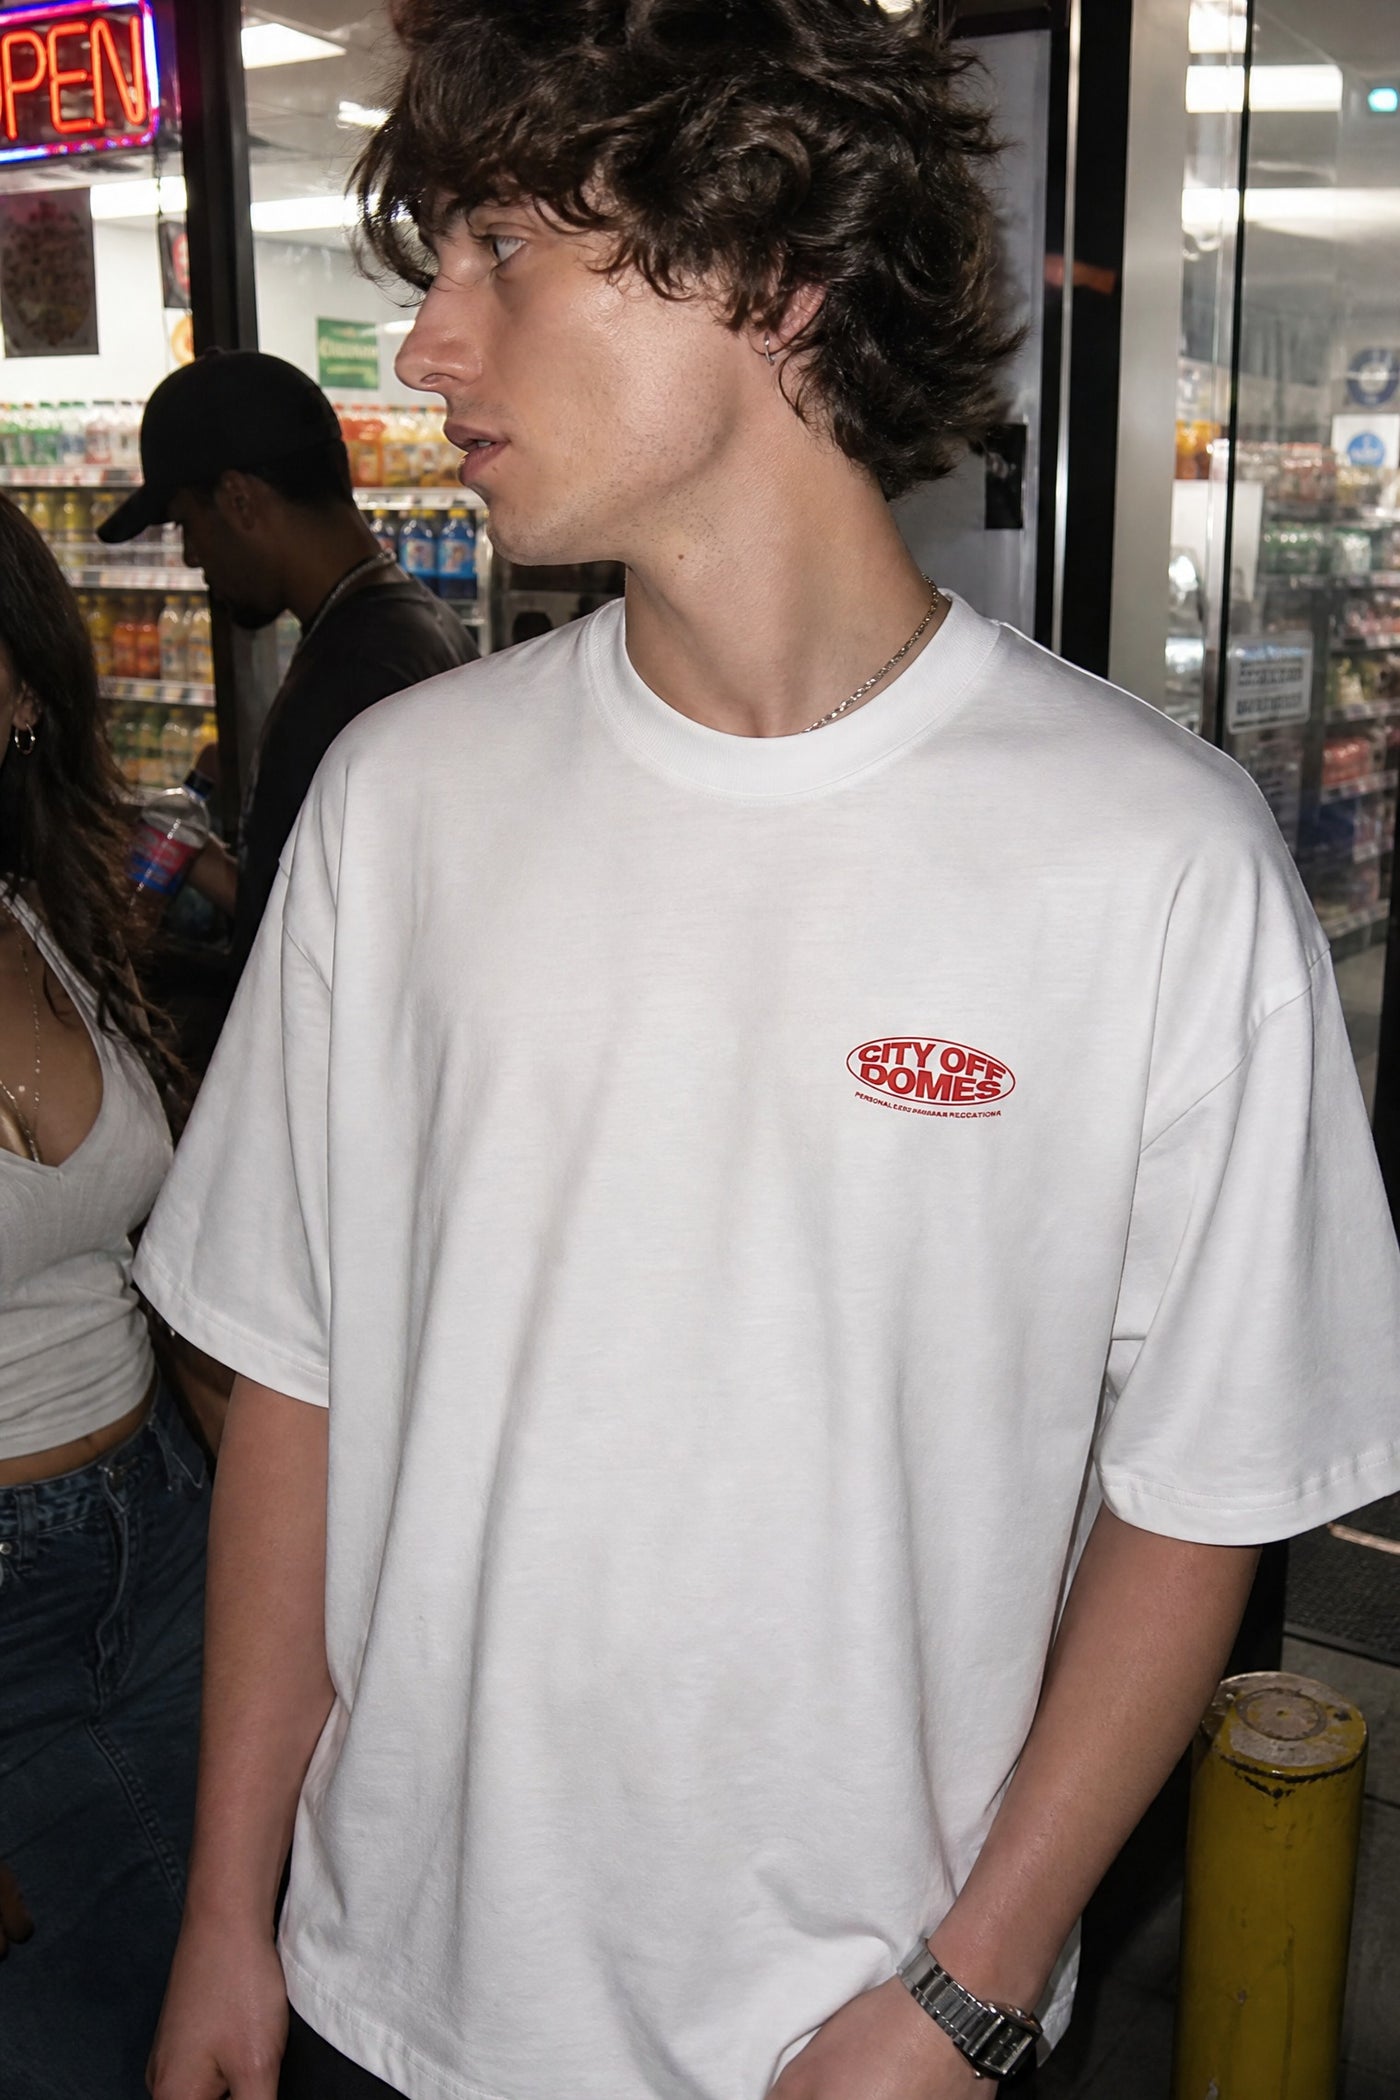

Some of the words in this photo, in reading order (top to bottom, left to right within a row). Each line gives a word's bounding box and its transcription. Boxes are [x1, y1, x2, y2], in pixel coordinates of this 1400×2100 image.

[0, 15, 147, 141] PEN
[858, 1042, 936, 1068] CITY
[940, 1047, 1006, 1080] OFF
[860, 1063, 1001, 1102] DOMES
